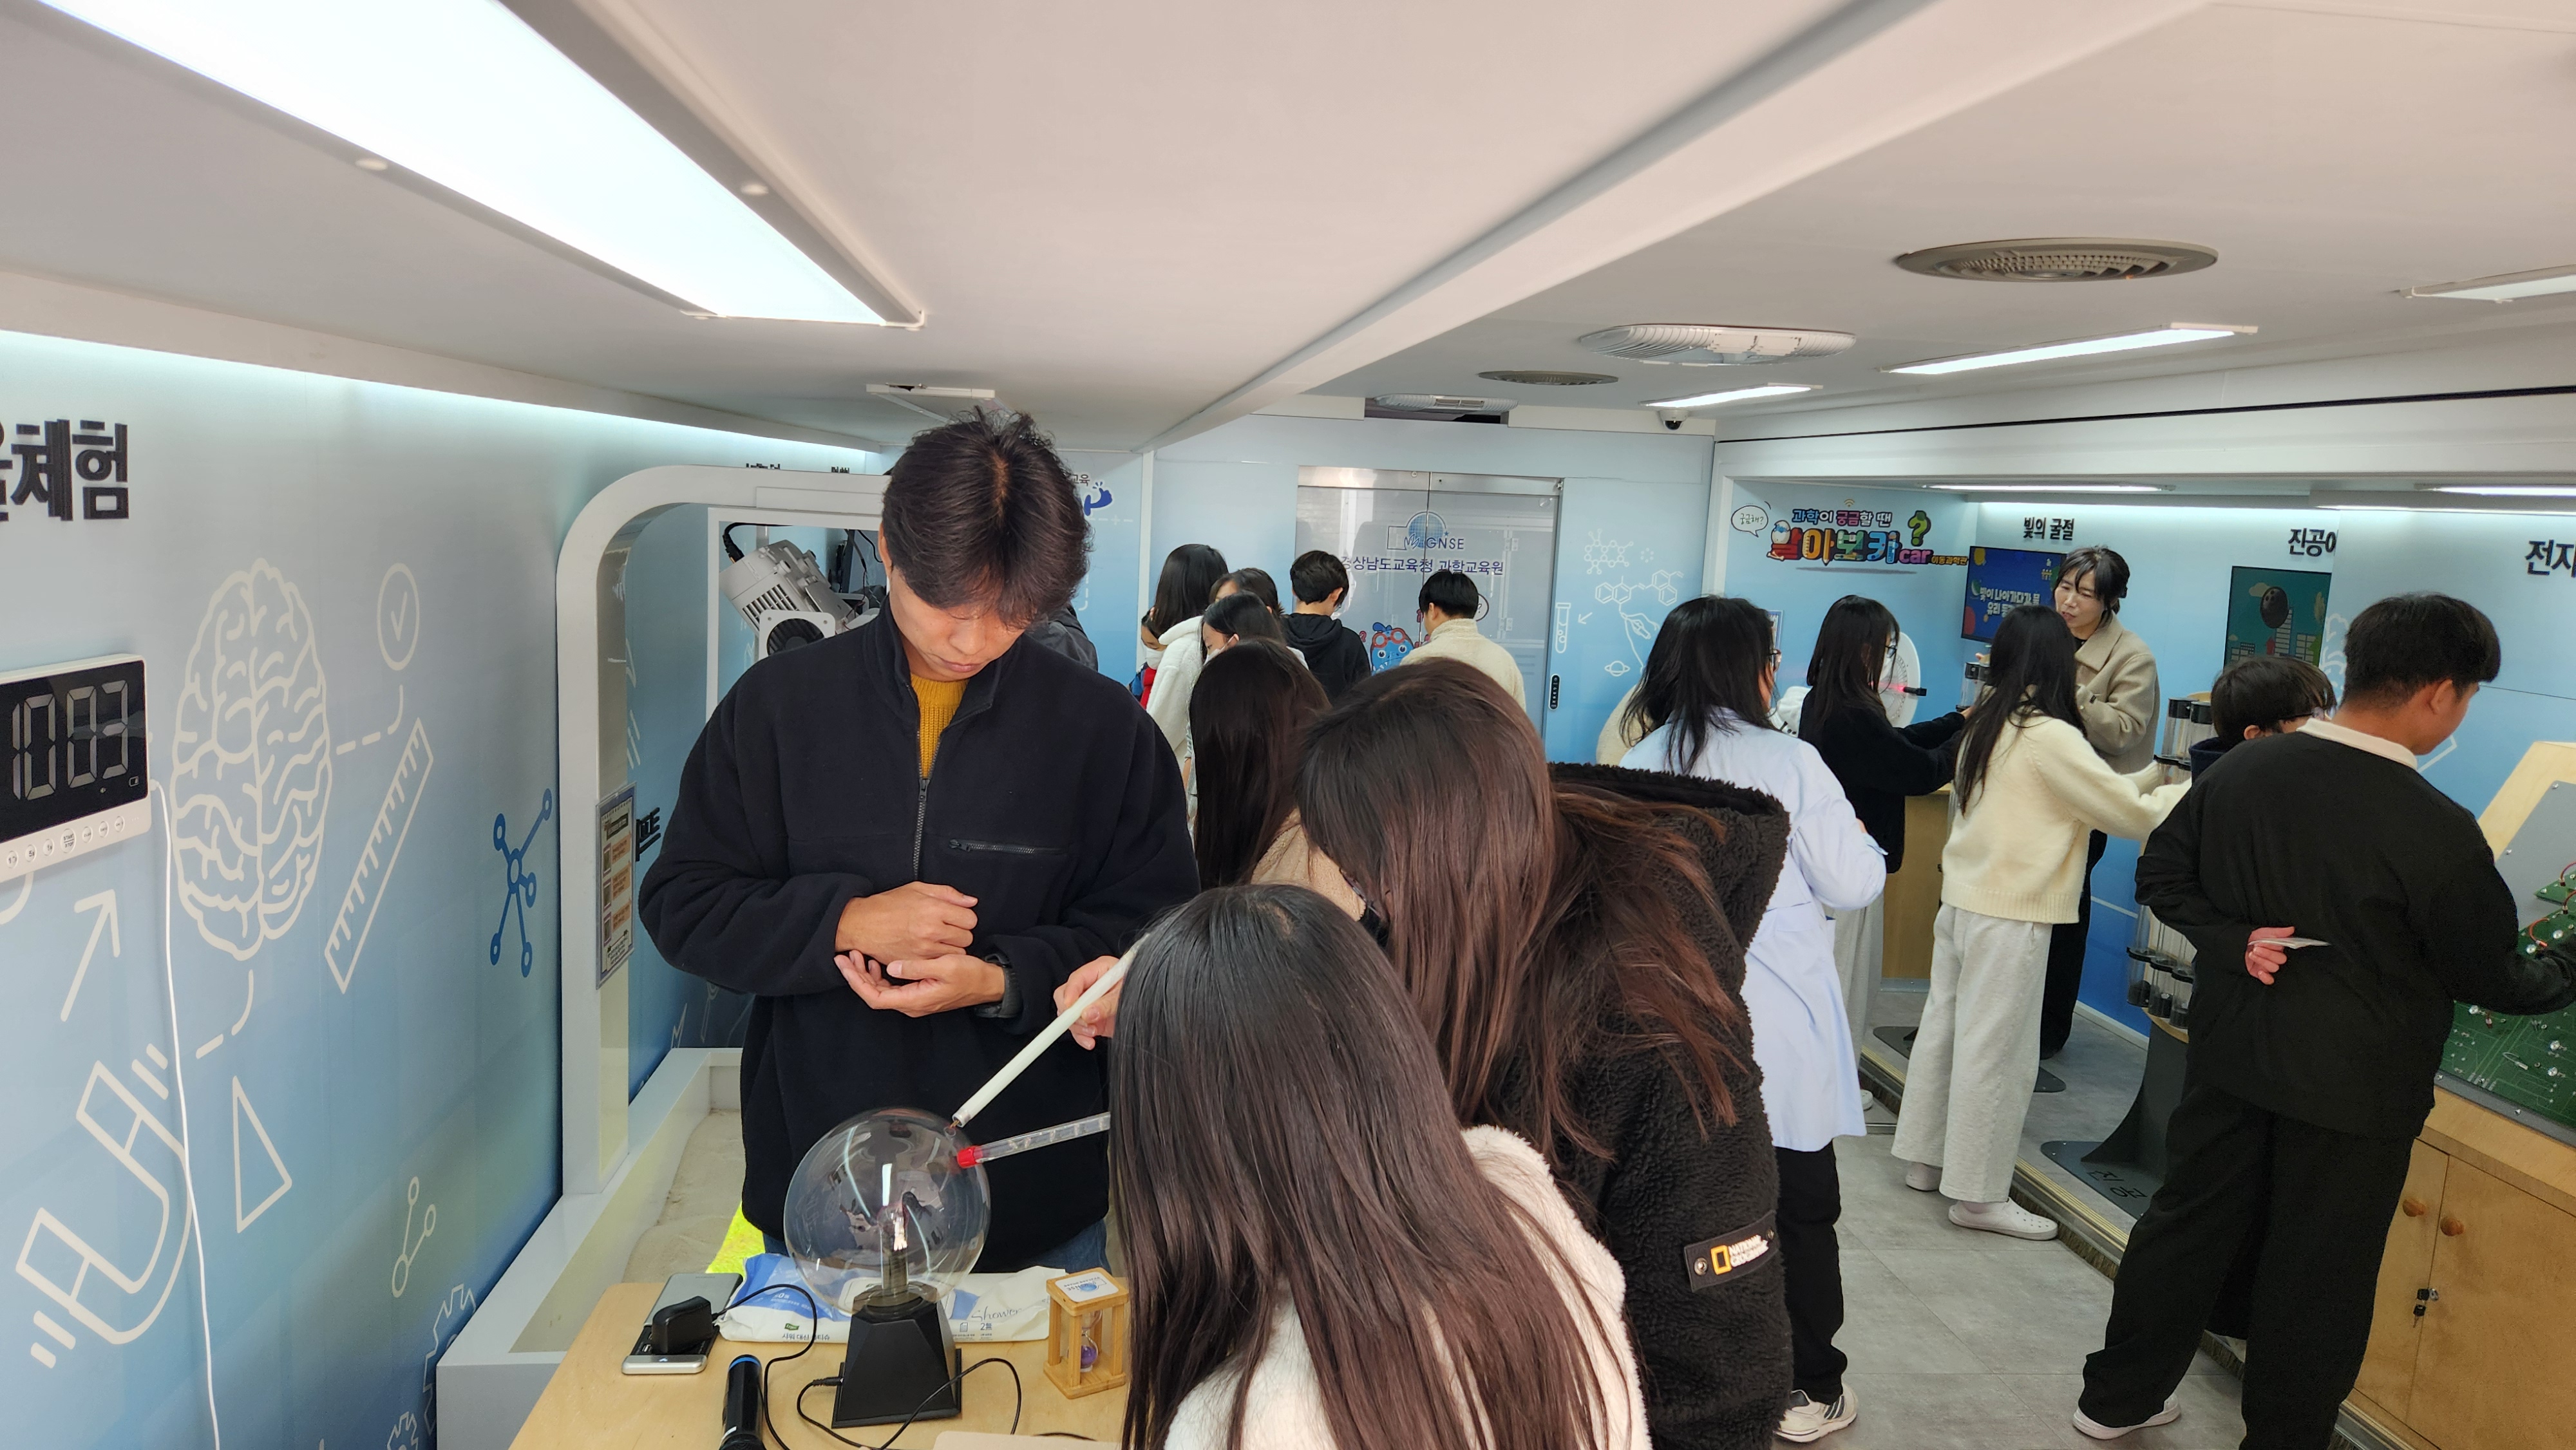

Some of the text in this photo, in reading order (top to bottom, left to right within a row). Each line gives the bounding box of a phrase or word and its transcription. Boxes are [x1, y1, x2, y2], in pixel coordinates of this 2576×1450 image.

[0, 419, 129, 522] 체험
[1739, 513, 1764, 525] 궁금해?
[1792, 509, 1892, 527] 과학이 궁금할 땐
[2023, 517, 2074, 540] 빛의 굴절
[1425, 538, 1464, 549] GNSE
[1341, 556, 1503, 576] 경상남도교육청 과학교육원
[1980, 587, 1994, 601] 빛이
[971, 1306, 1022, 1321] Shower
